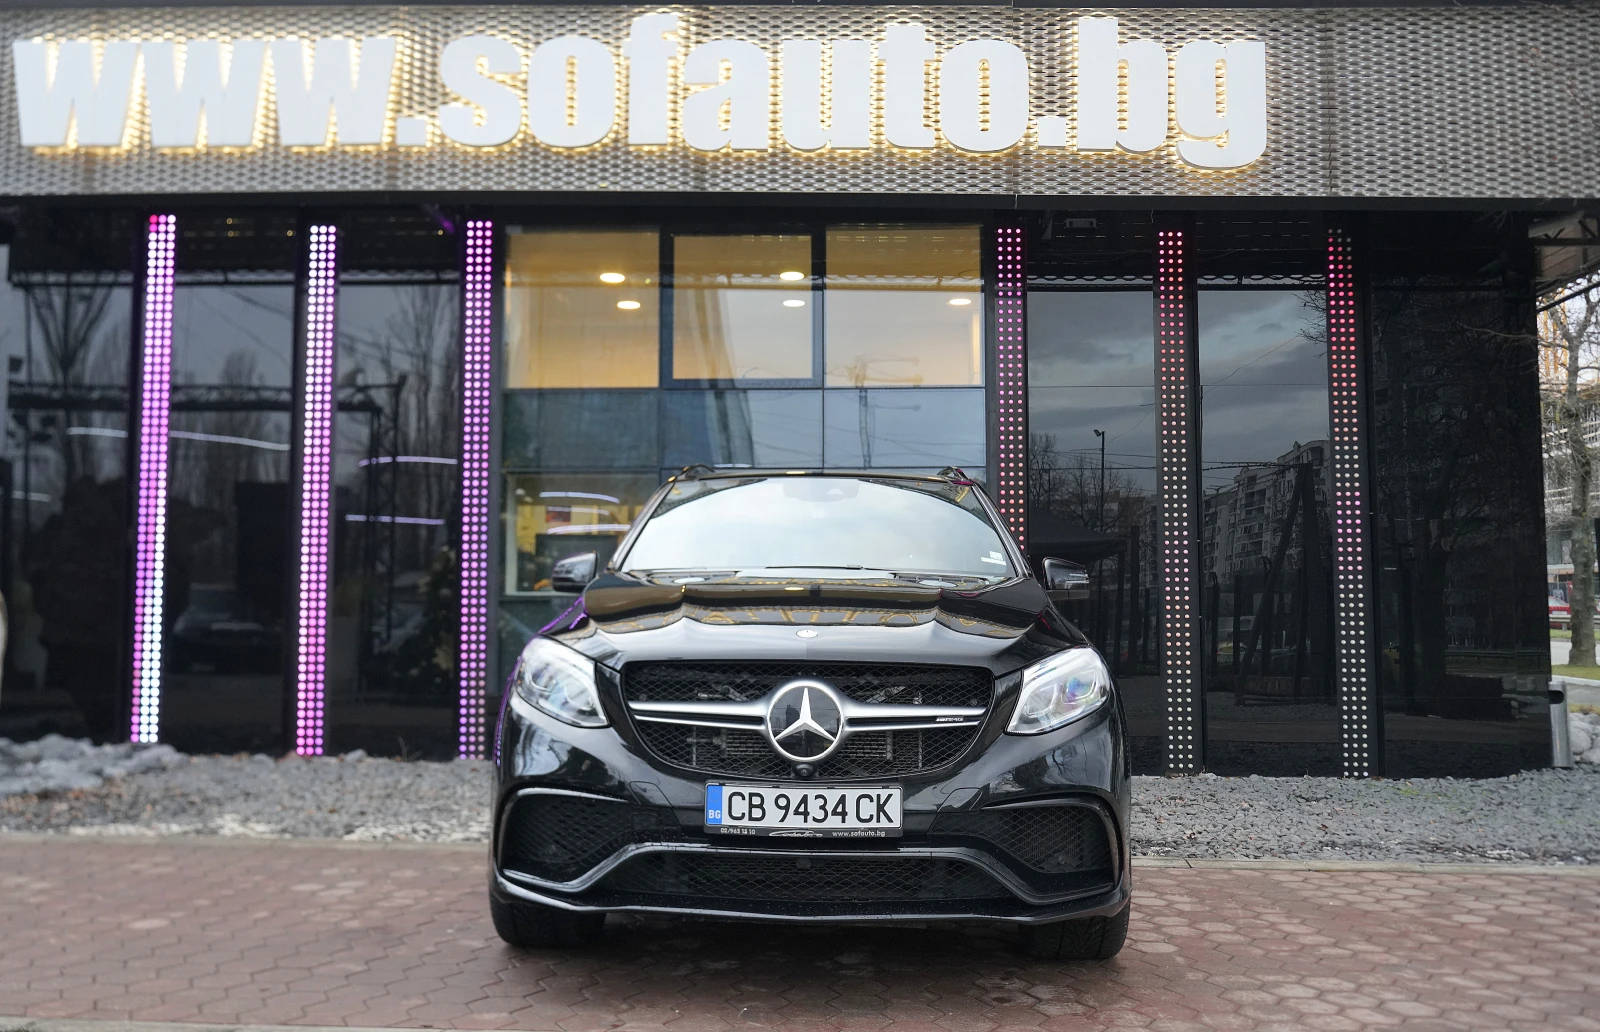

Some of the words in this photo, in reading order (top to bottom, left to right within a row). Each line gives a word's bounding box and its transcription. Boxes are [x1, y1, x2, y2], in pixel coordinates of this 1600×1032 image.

[12, 12, 1267, 169] www.sofauto.bg
[708, 810, 722, 819] BG
[727, 791, 767, 822] CB
[774, 793, 848, 824] 9434
[855, 793, 894, 824] CK
